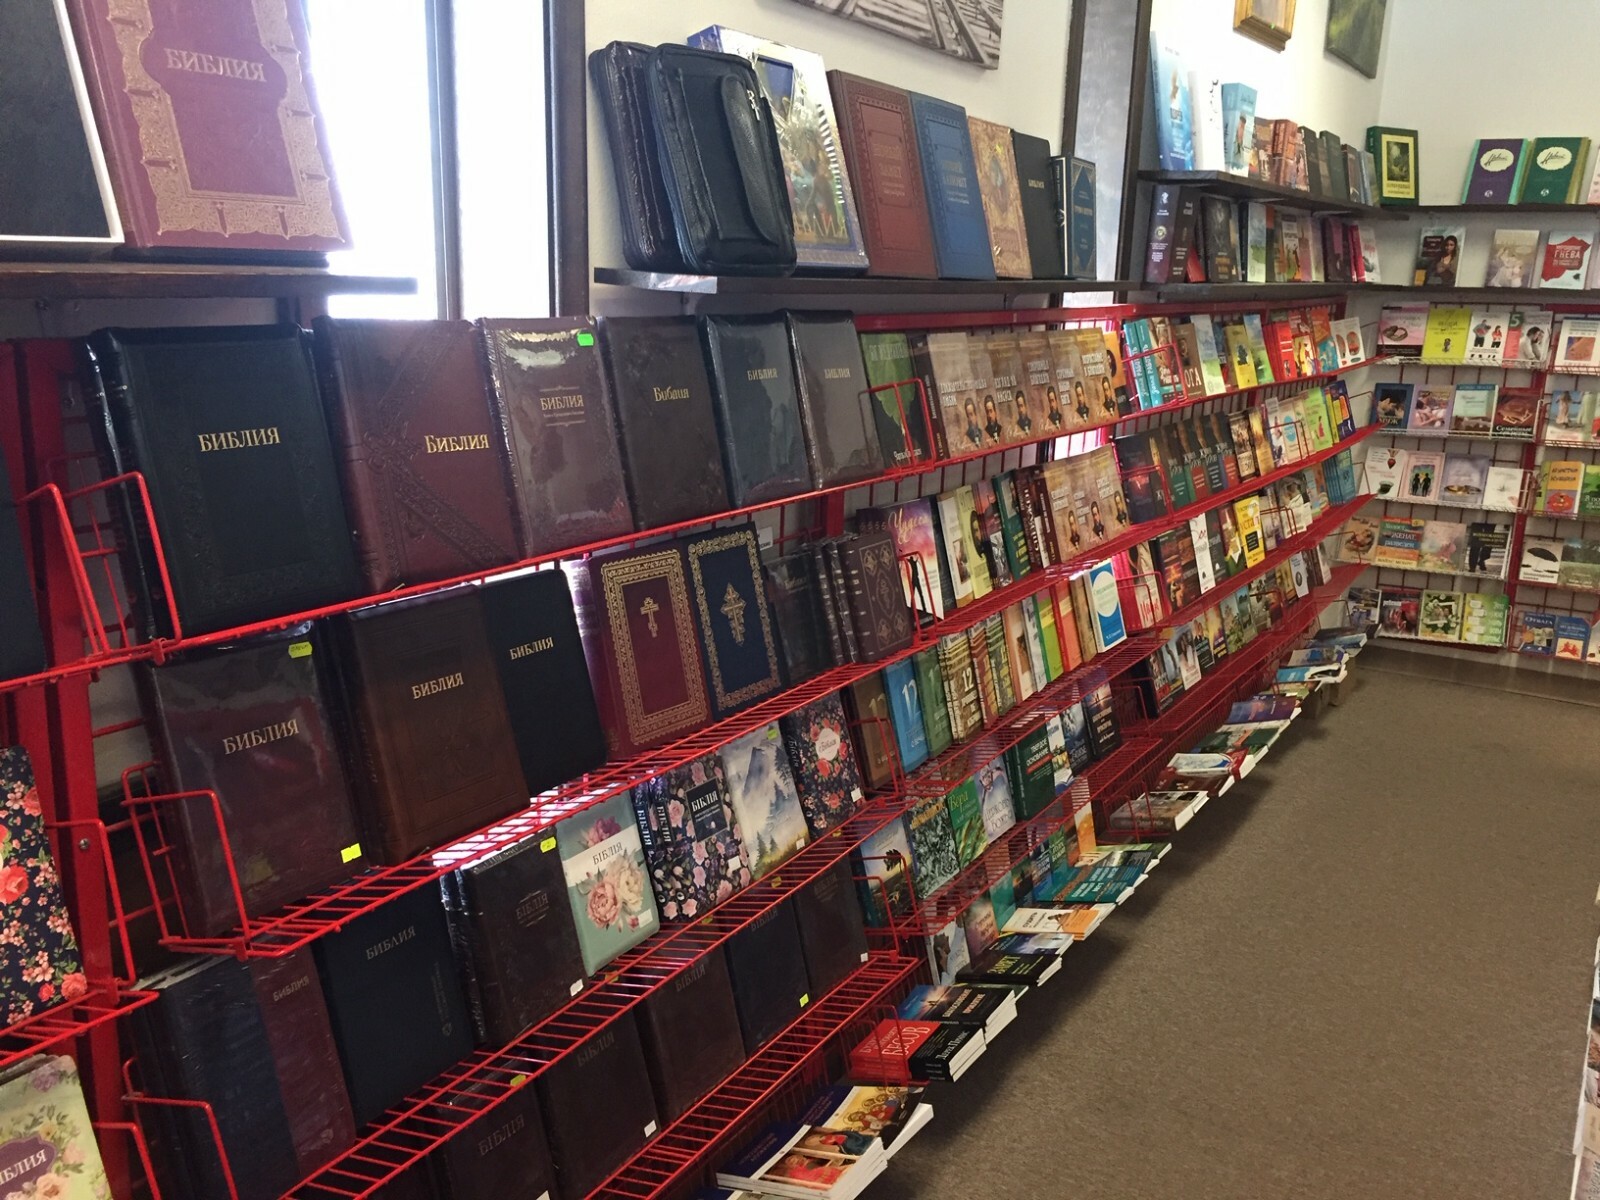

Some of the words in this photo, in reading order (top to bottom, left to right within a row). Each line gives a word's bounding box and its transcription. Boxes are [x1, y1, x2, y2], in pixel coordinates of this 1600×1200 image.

[163, 48, 267, 83] БИБЛИЯ
[1510, 313, 1522, 327] 5
[747, 368, 778, 381] БИБЛИЯ
[540, 394, 585, 411] БИБЛИЯ
[653, 387, 690, 402] Библия
[198, 427, 281, 452] БИБЛИЯ
[424, 434, 490, 454] БИБЛИЯ
[510, 637, 554, 660] БИБЛИЯ
[412, 672, 464, 700] БИБЛИЯ
[222, 718, 299, 755] БИБЛИЯ
[691, 790, 719, 812] БІБЛІЯ
[593, 842, 623, 866] БІБЛІЯ
[516, 893, 548, 919] БІБЛІЯ
[366, 926, 416, 960] БИБЛИЯ
[273, 976, 310, 1001] БИБЛИЯ
[675, 965, 705, 992] БІБЛІЯ
[478, 1113, 525, 1156] БІБЛІЯ
